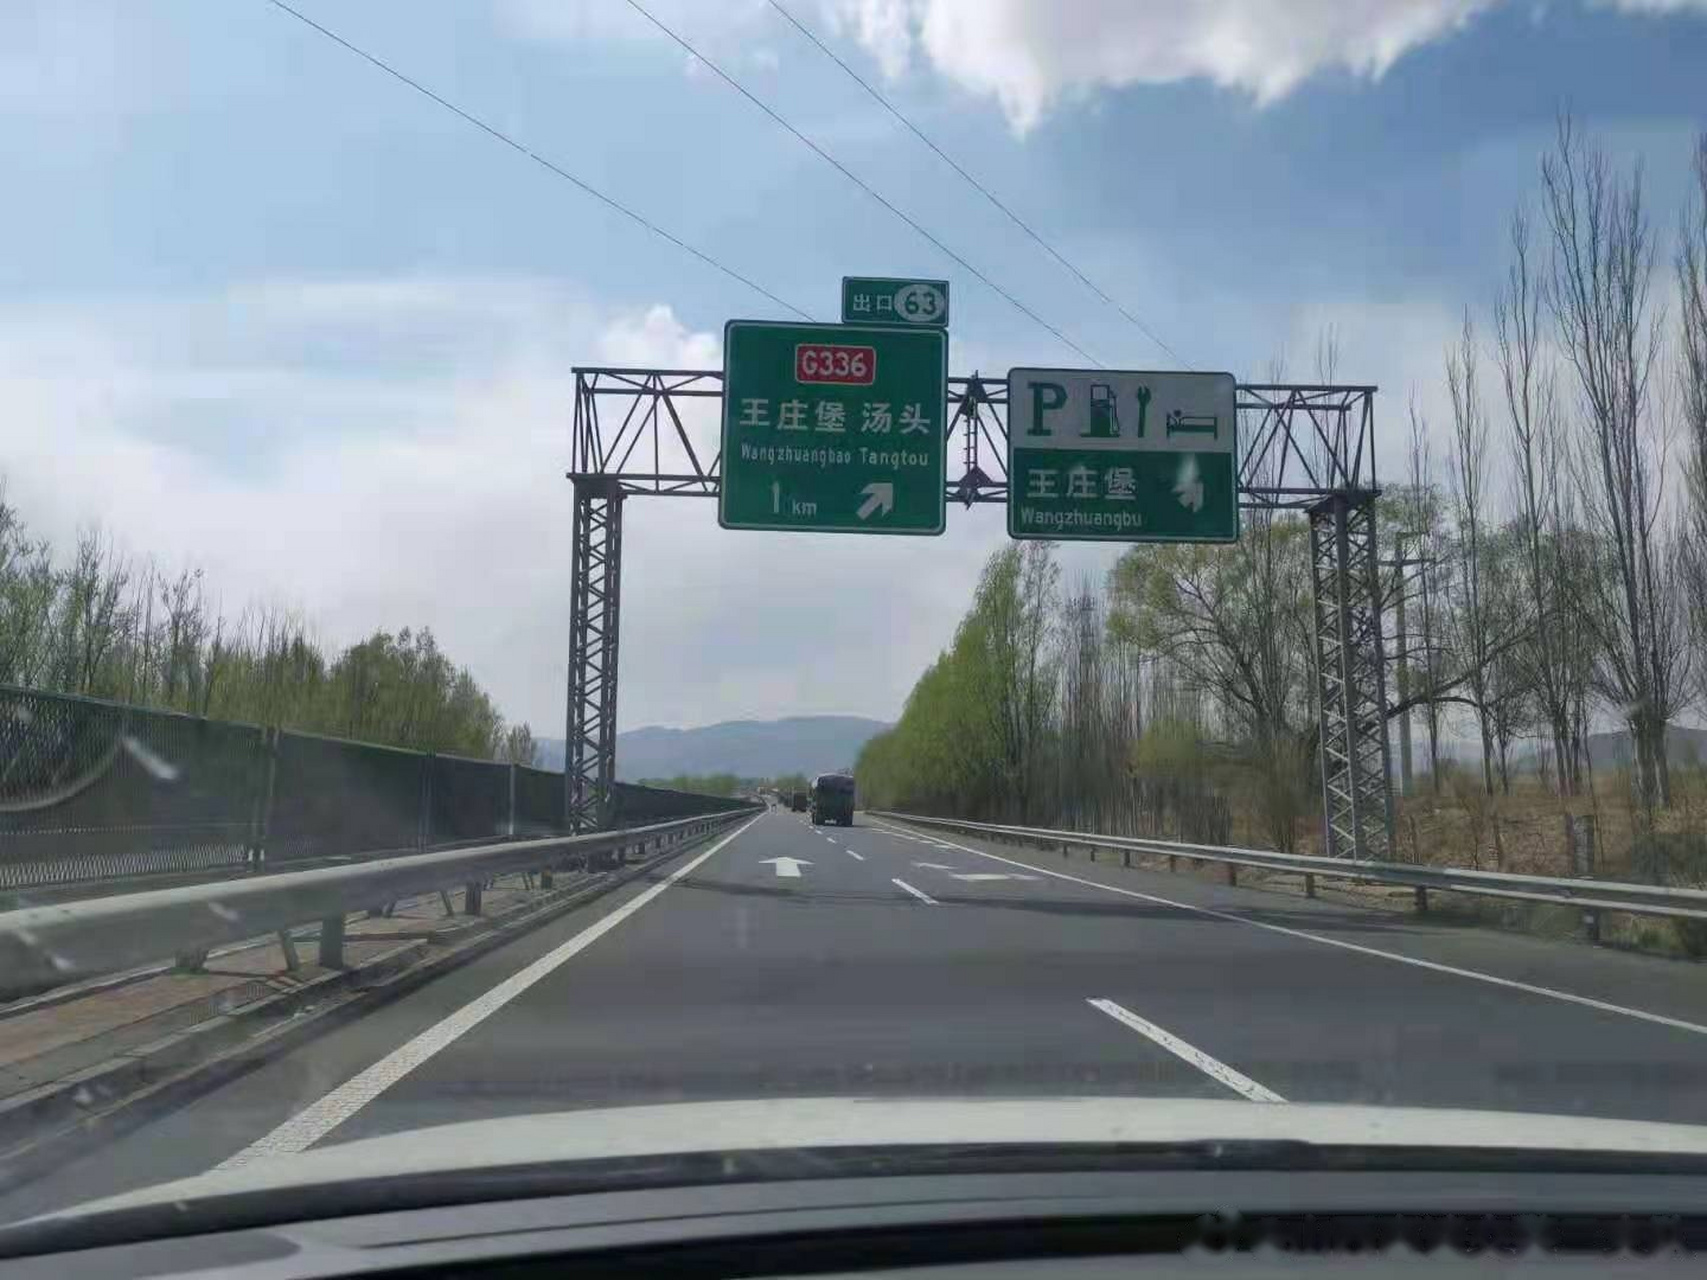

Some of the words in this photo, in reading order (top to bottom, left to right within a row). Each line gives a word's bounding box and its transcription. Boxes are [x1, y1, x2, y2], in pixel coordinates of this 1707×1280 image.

[852, 293, 893, 312] 出口
[904, 291, 938, 315] 63
[802, 350, 867, 376] G336
[739, 398, 846, 432] 王庄堡
[861, 402, 931, 434] 汤头
[1027, 382, 1068, 436] P
[861, 447, 929, 470] Tangtou
[771, 481, 781, 513] 1
[792, 500, 817, 515] km
[1027, 465, 1137, 500] 王庄堡
